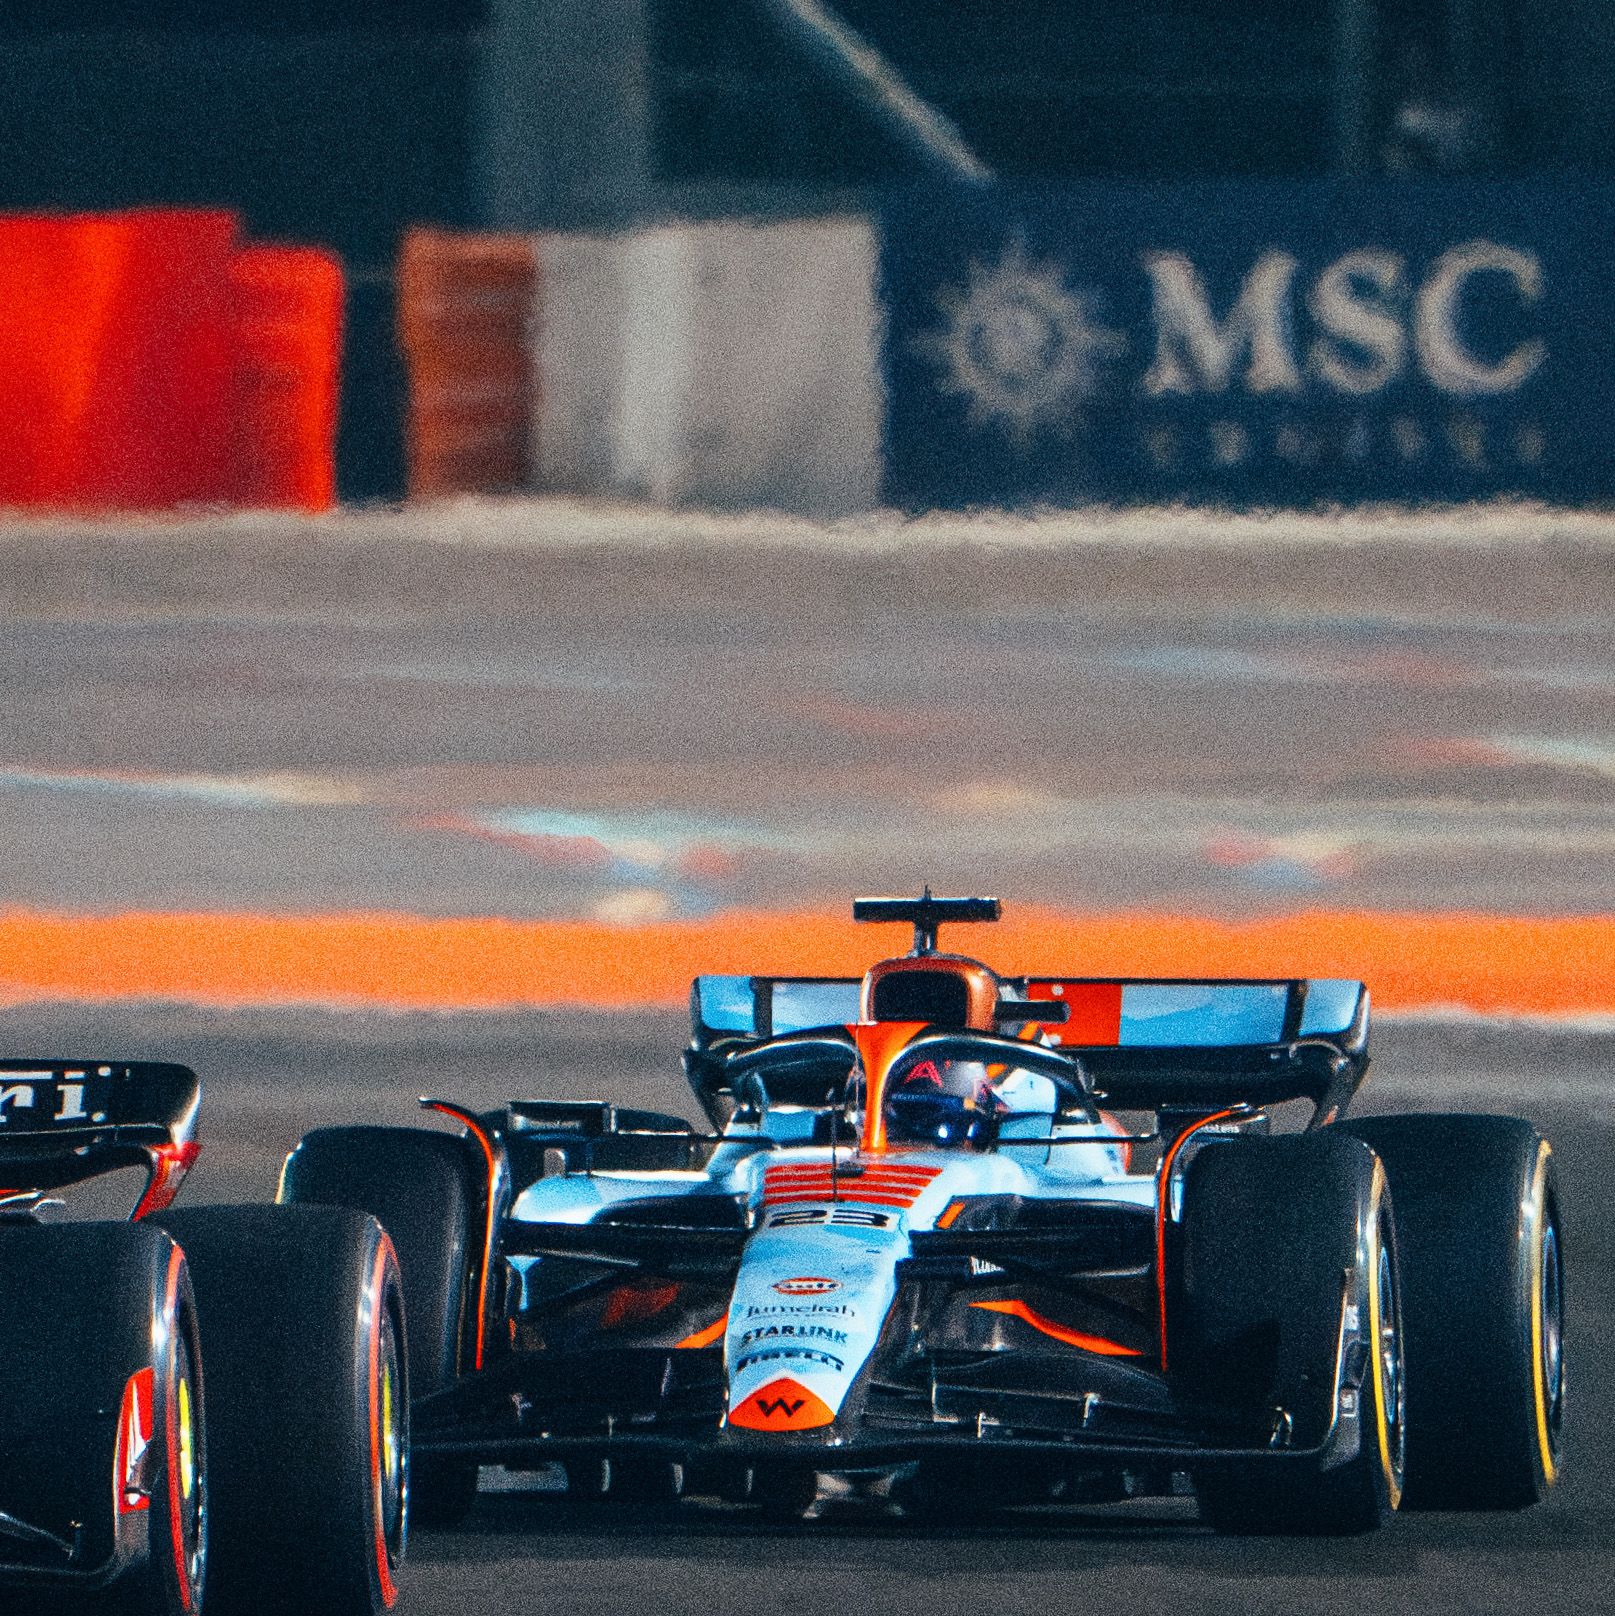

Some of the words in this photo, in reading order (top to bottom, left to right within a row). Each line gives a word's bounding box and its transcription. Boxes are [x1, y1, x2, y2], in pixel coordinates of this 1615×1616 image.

[1142, 238, 1545, 396] MSC
[768, 1208, 890, 1228] 23
[741, 1325, 849, 1345] STARLINK
